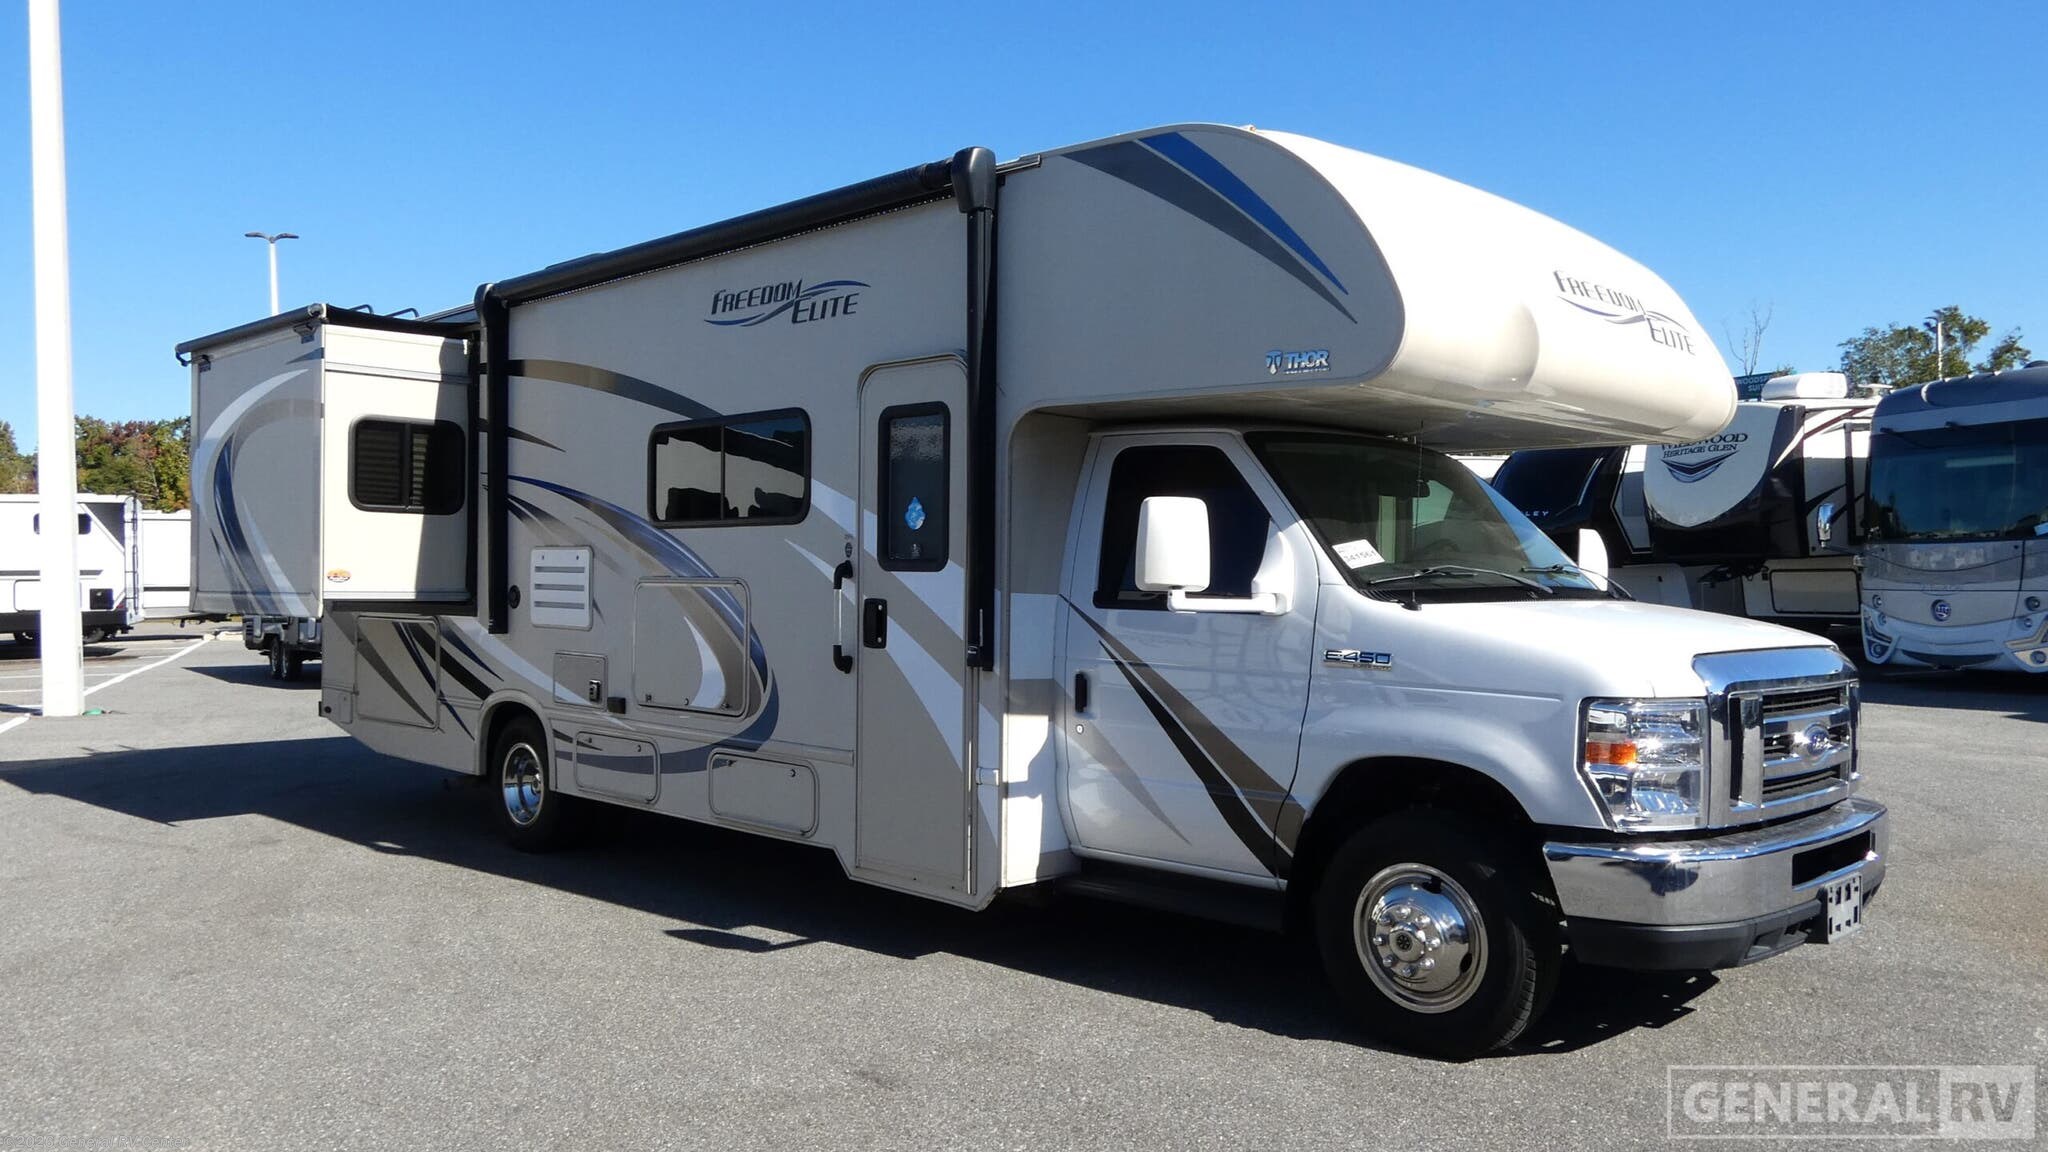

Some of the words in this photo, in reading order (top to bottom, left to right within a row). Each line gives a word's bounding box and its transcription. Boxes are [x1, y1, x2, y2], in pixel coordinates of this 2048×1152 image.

[711, 279, 803, 315] FREEDOM
[1553, 270, 1647, 316] FREEDOM
[791, 293, 860, 325] ELITE
[1646, 317, 1696, 356] ELITE
[1287, 350, 1330, 369] THOR
[1736, 375, 1769, 384] WOODSP
[1663, 446, 1706, 459] HERITAGE
[1708, 443, 1738, 452] GLEN
[1324, 649, 1392, 666] E450
